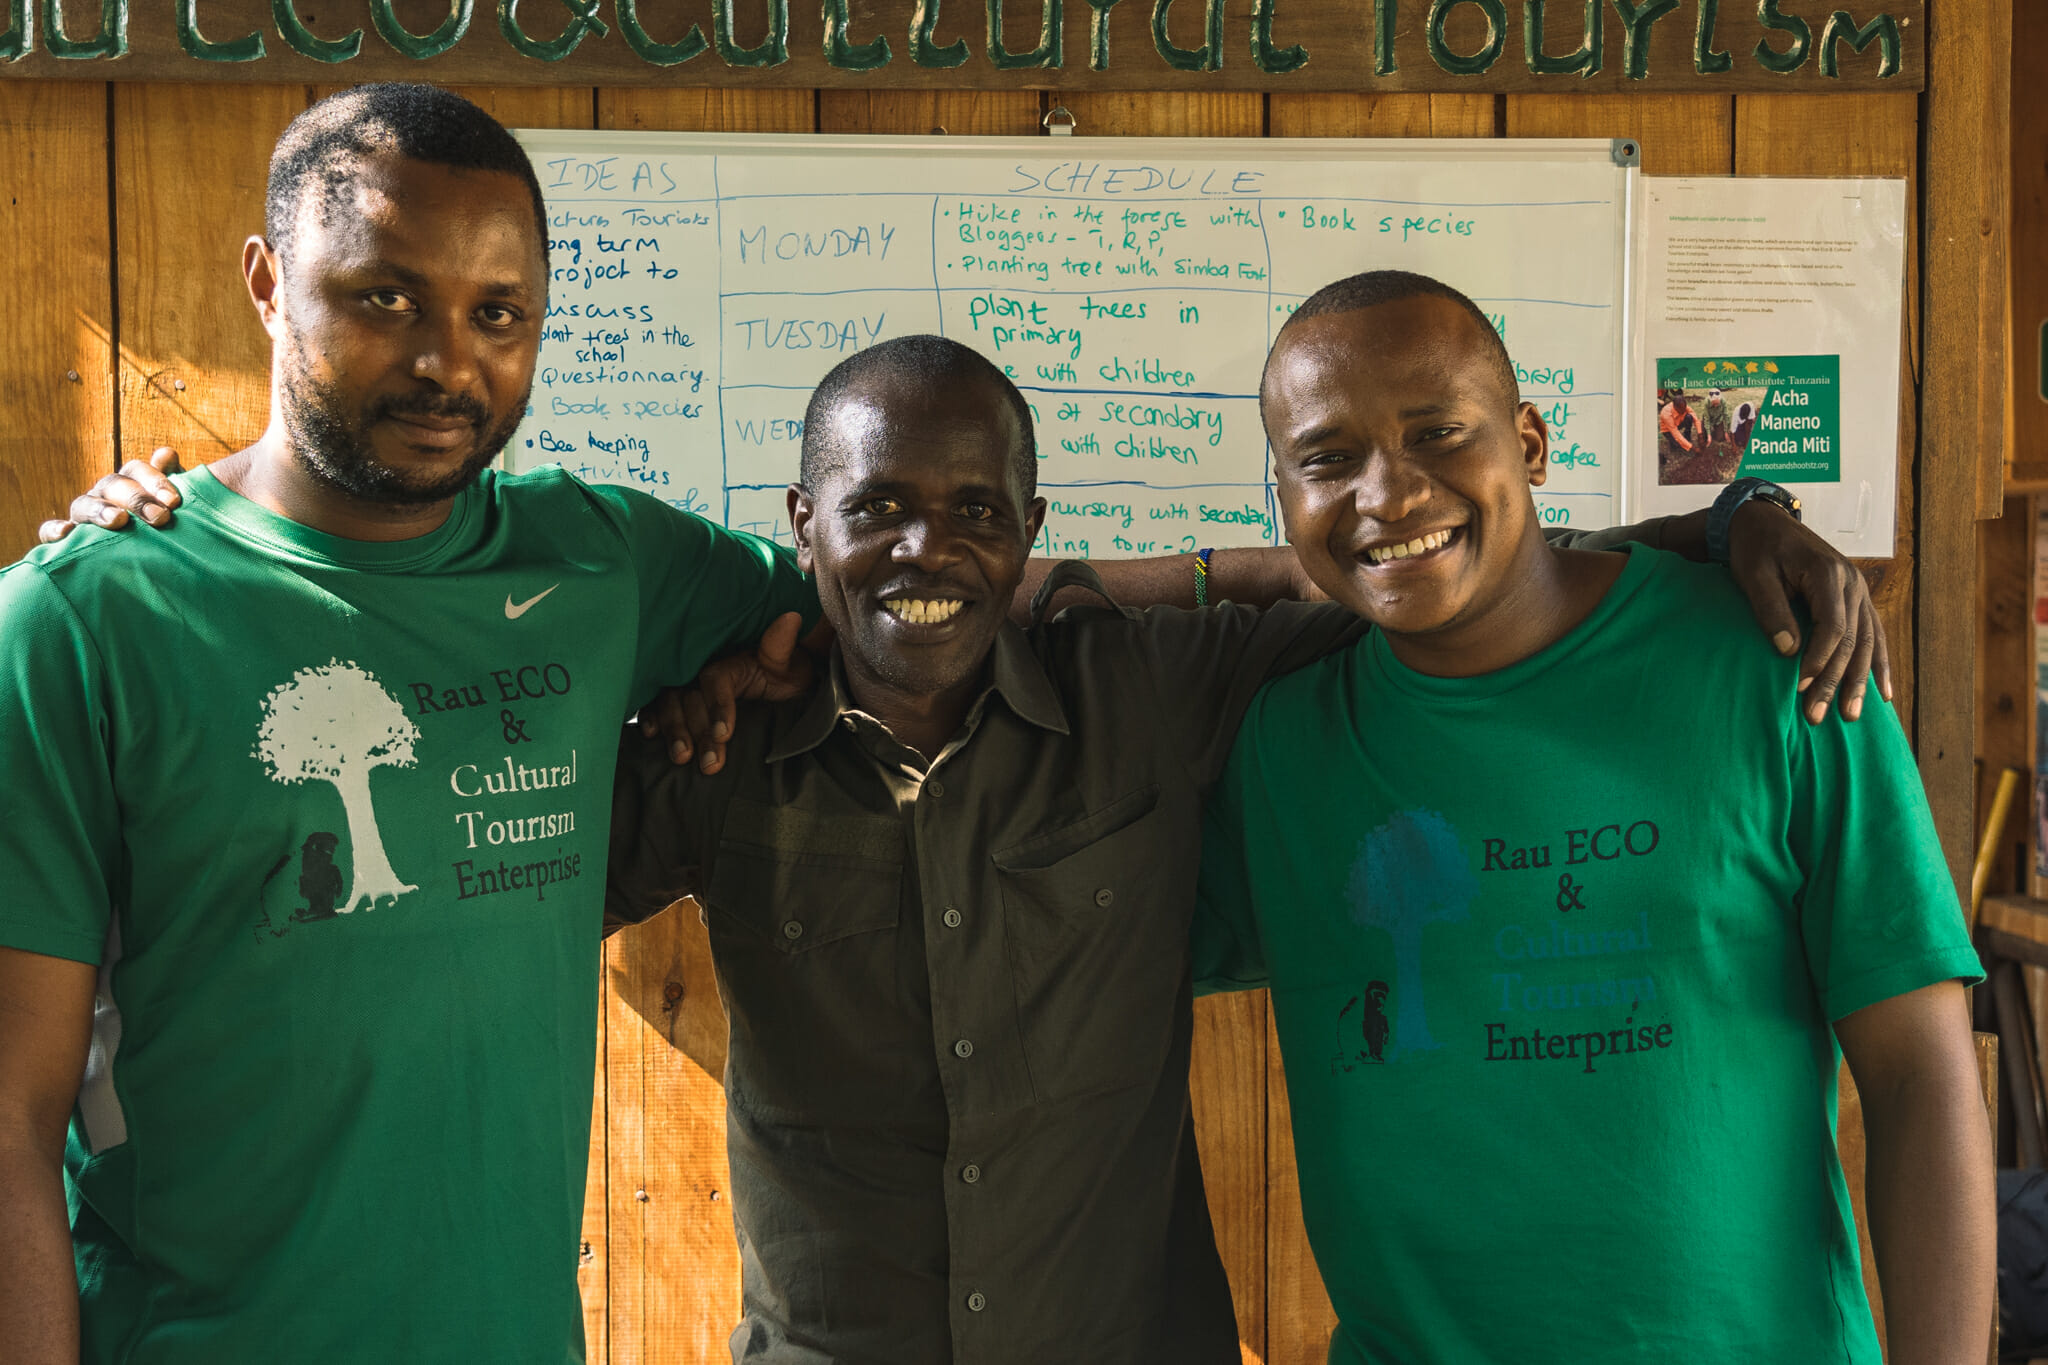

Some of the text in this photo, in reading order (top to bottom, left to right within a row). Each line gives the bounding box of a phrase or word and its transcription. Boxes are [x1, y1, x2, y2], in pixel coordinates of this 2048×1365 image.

[547, 157, 678, 196] IDEAS
[1008, 162, 1265, 195] SCHEDULE
[1039, 205, 1057, 220] in
[1073, 204, 1104, 225] the
[1209, 206, 1260, 227] with
[1302, 206, 1475, 242] Book species
[549, 234, 582, 265] ong
[739, 222, 896, 265] MONDAY
[549, 258, 679, 290] roject to
[962, 255, 1049, 281] Planting
[1061, 257, 1103, 277] tree
[1115, 256, 1159, 277] with
[1174, 258, 1229, 278] Simba
[969, 293, 1199, 330] plant trees in
[581, 329, 630, 347] trees
[642, 326, 655, 344] in
[661, 325, 695, 347] the
[735, 312, 885, 353] TUESDAY
[993, 324, 1082, 360] primary
[575, 344, 625, 364] school
[1037, 362, 1077, 384] with
[1099, 357, 1195, 387] children
[1664, 375, 1830, 389] the Jane Goodall Institute Tanzania
[623, 398, 704, 420] species
[1771, 389, 1809, 406] Acha
[1057, 403, 1081, 422] at
[1099, 402, 1222, 446] secondary
[1760, 414, 1820, 430] Maneno
[539, 430, 577, 452] Bee
[1061, 432, 1100, 456] with
[1751, 436, 1831, 454] Panda Miti
[556, 461, 670, 485] ctivities
[1051, 501, 1134, 528] nursery
[1150, 504, 1188, 520] with
[408, 663, 572, 715] Rau ECO
[500, 709, 532, 744] &
[450, 750, 577, 797] Cultural
[455, 810, 576, 849] Tourism
[1481, 820, 1660, 871] Rau ECO
[452, 848, 581, 901] Enterprise
[1556, 873, 1586, 913] &
[1494, 911, 1652, 960] Cultural
[1492, 972, 1655, 1013] Tourism
[1483, 1016, 1673, 1074] Enterprise
